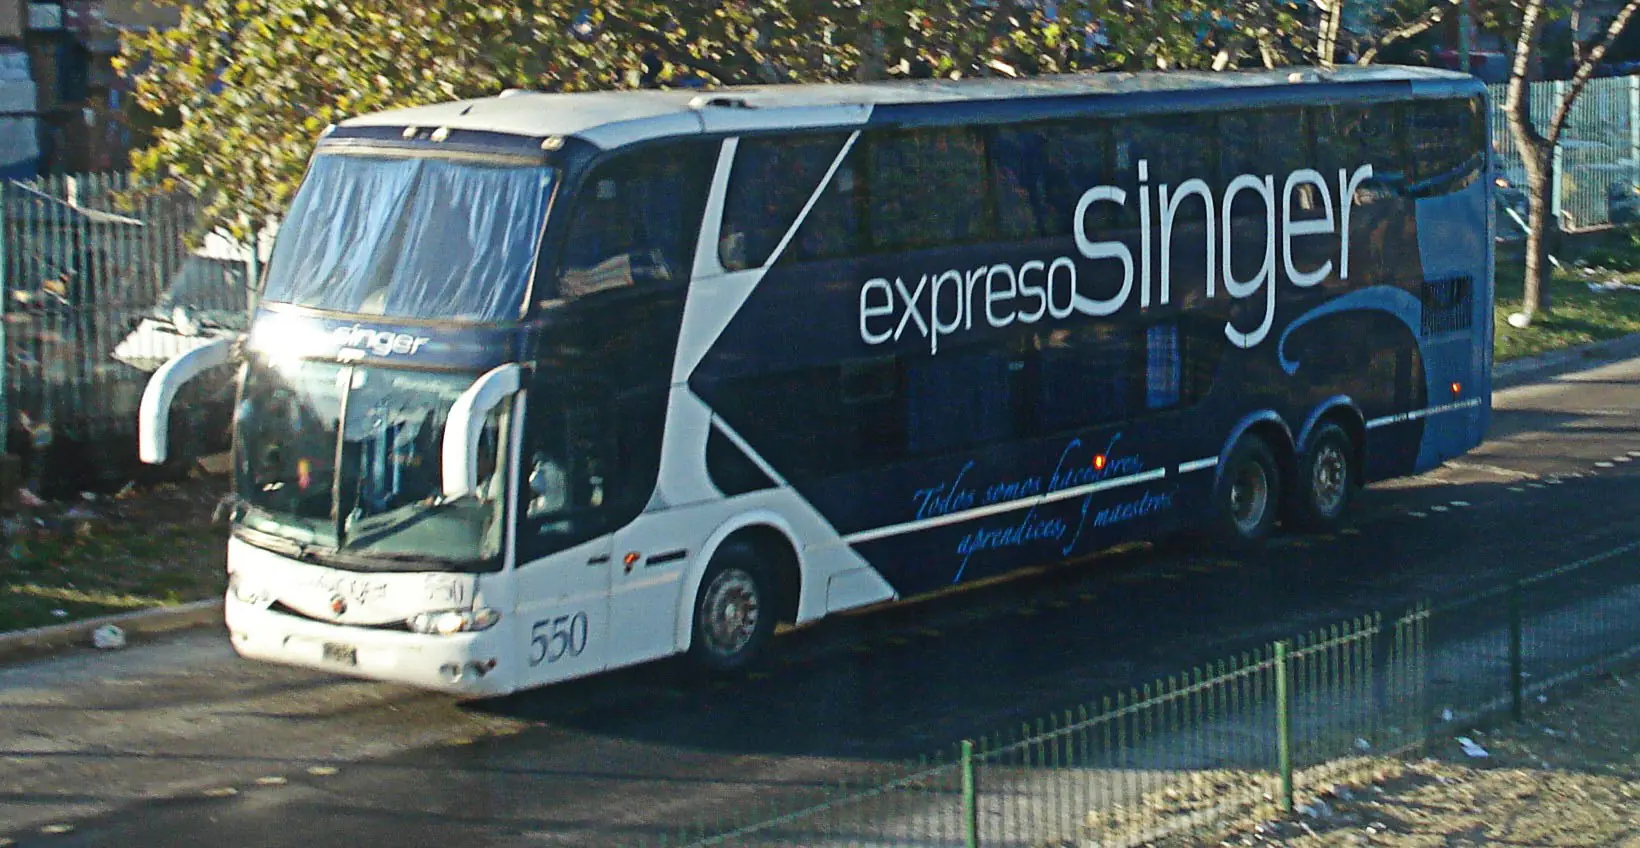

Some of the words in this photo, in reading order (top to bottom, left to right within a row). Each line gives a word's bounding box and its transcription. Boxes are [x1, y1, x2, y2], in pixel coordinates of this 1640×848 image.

[860, 256, 1076, 354] expreso
[1073, 159, 1373, 347] singer
[528, 611, 588, 667] 550
